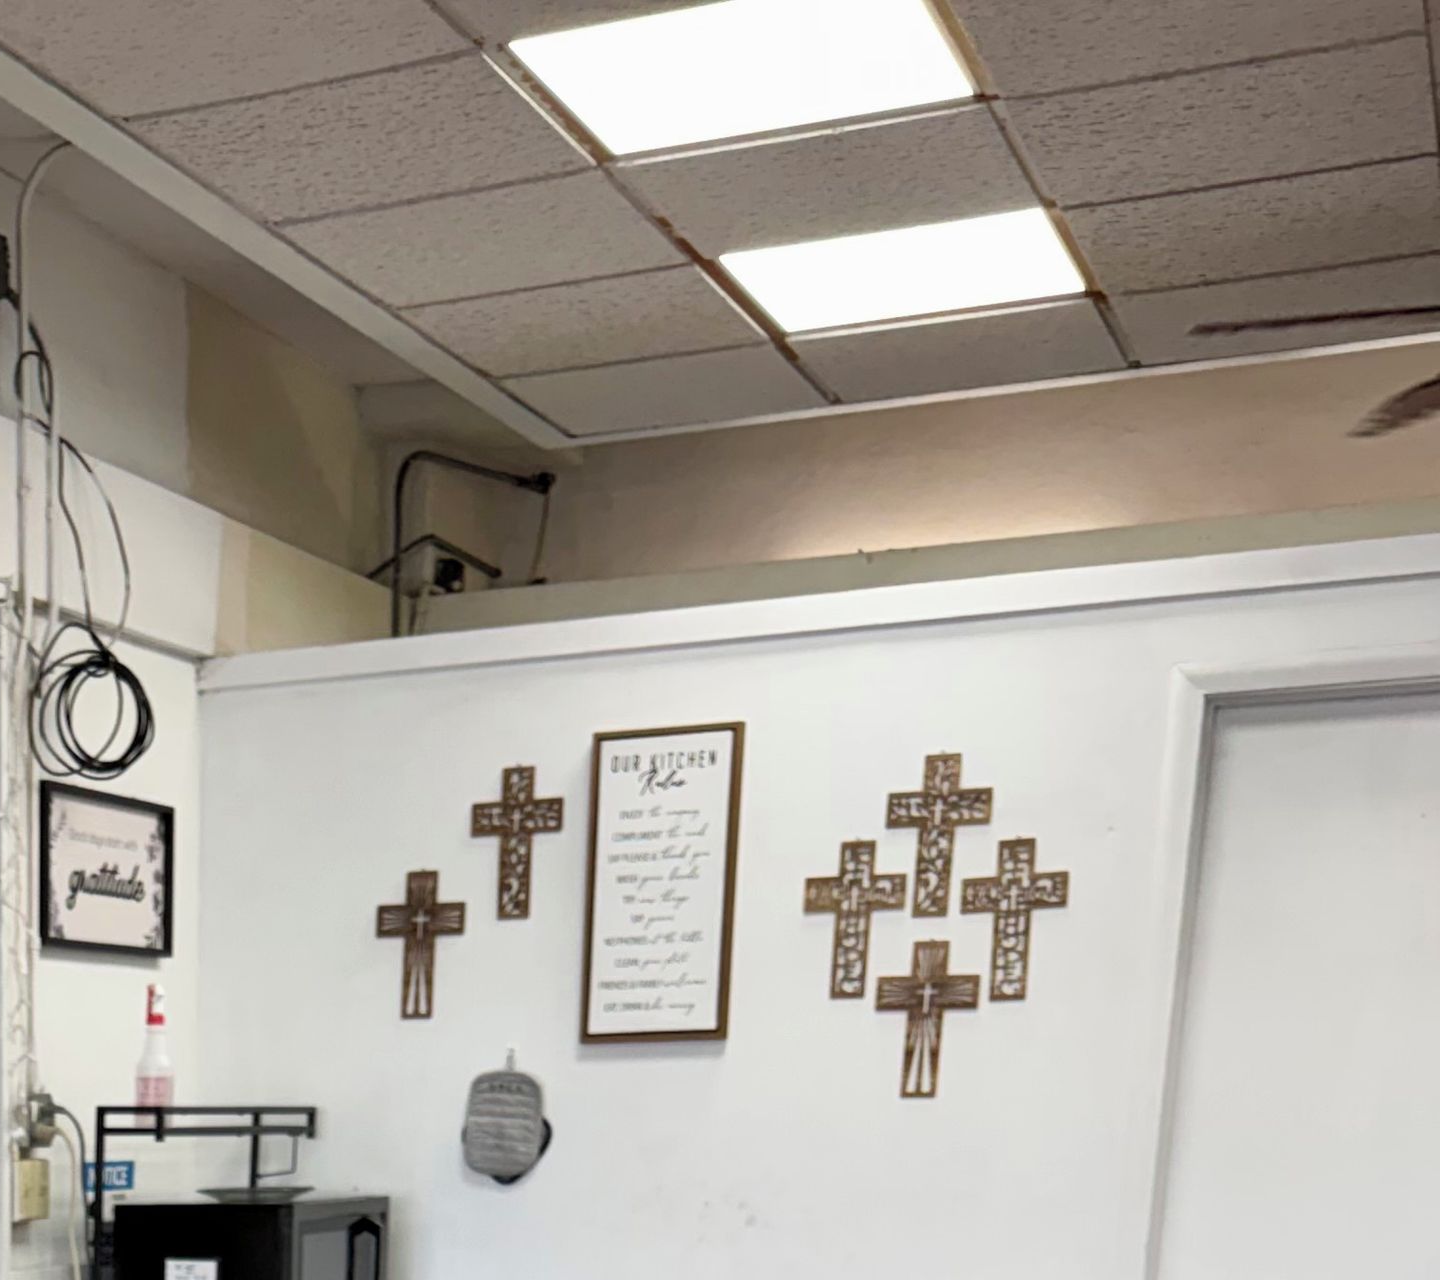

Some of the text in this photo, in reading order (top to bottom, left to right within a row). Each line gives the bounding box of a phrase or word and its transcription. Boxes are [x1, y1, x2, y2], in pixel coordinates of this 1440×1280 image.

[611, 750, 717, 773] OUR KITCHEN
[87, 1166, 129, 1188] NTICE
